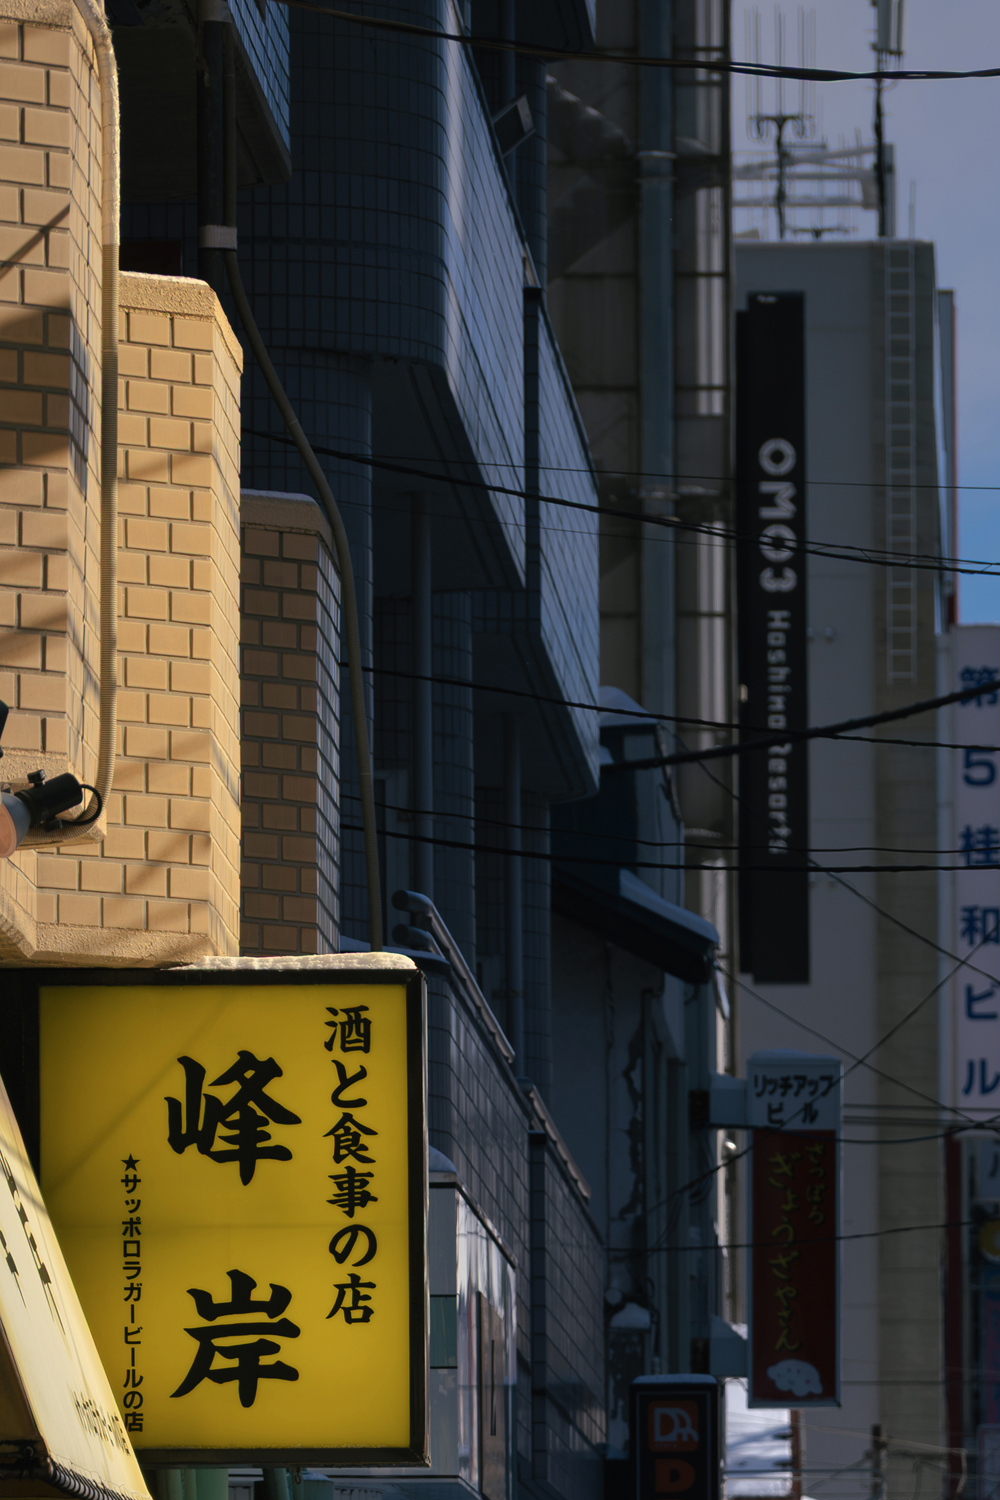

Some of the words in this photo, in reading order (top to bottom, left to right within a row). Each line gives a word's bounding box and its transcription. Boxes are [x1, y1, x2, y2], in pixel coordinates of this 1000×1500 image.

[758, 437, 797, 593] OMO3
[767, 610, 792, 730] Hoshino
[767, 740, 792, 854] Resorts
[754, 1075, 833, 1097] リッチアップ
[768, 1102, 819, 1124] ビル
[164, 1050, 302, 1408] 峰岸
[323, 1005, 378, 1324] 酒と食事の店
[121, 1174, 144, 1433] サッポロラガービールの店
